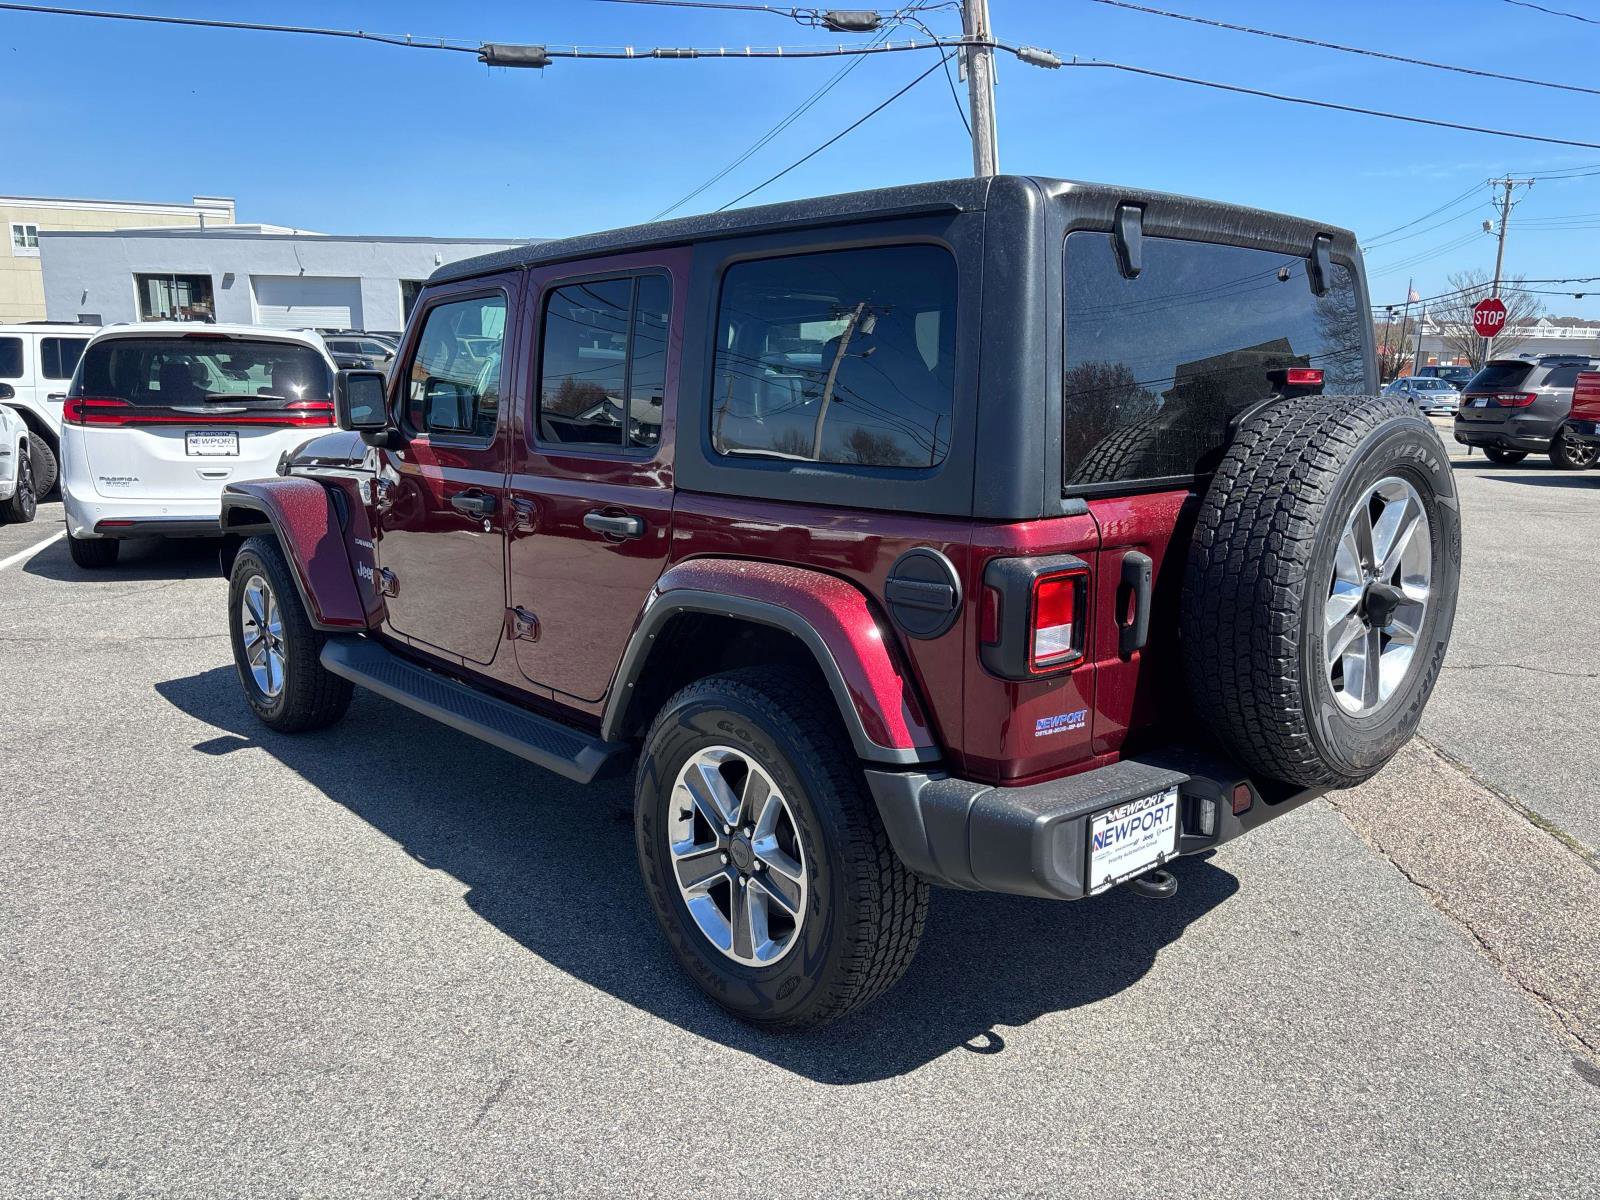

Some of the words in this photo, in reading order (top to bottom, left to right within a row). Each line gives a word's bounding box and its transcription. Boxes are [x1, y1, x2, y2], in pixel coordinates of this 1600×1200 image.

[1475, 310, 1505, 326] STOP
[1036, 710, 1087, 730] NEWPORT
[1112, 792, 1164, 821] NEWPORT
[1092, 803, 1174, 852] NEWPORT
